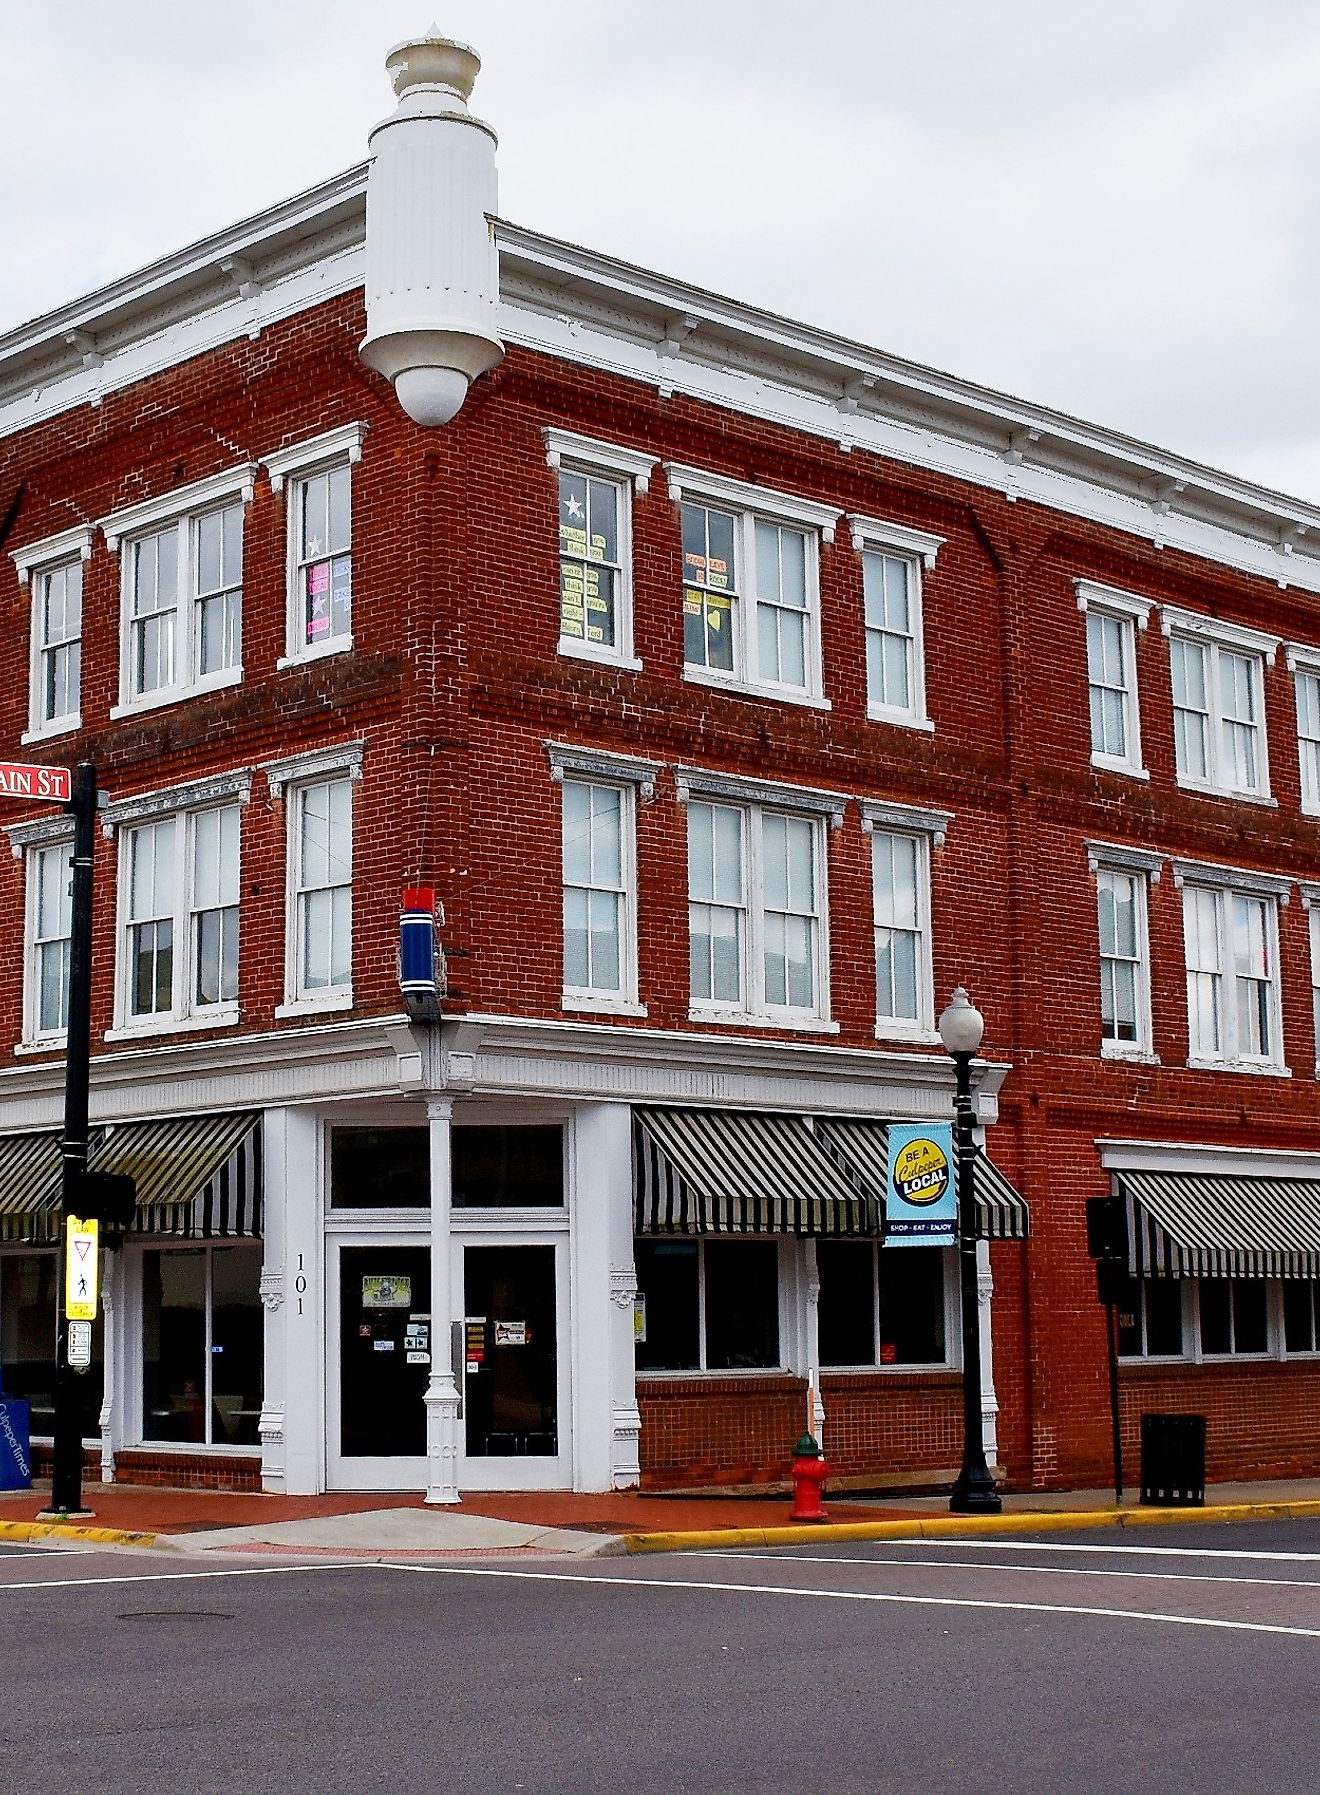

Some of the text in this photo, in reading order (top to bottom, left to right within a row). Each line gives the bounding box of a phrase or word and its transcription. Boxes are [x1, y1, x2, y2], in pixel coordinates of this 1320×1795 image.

[37, 769, 64, 797] ST
[905, 1146, 930, 1163] BE A
[903, 1169, 947, 1195] LOCAL
[890, 1224, 909, 1232] SHOP
[930, 1223, 952, 1231] ENJOY
[295, 1253, 307, 1316] 101
